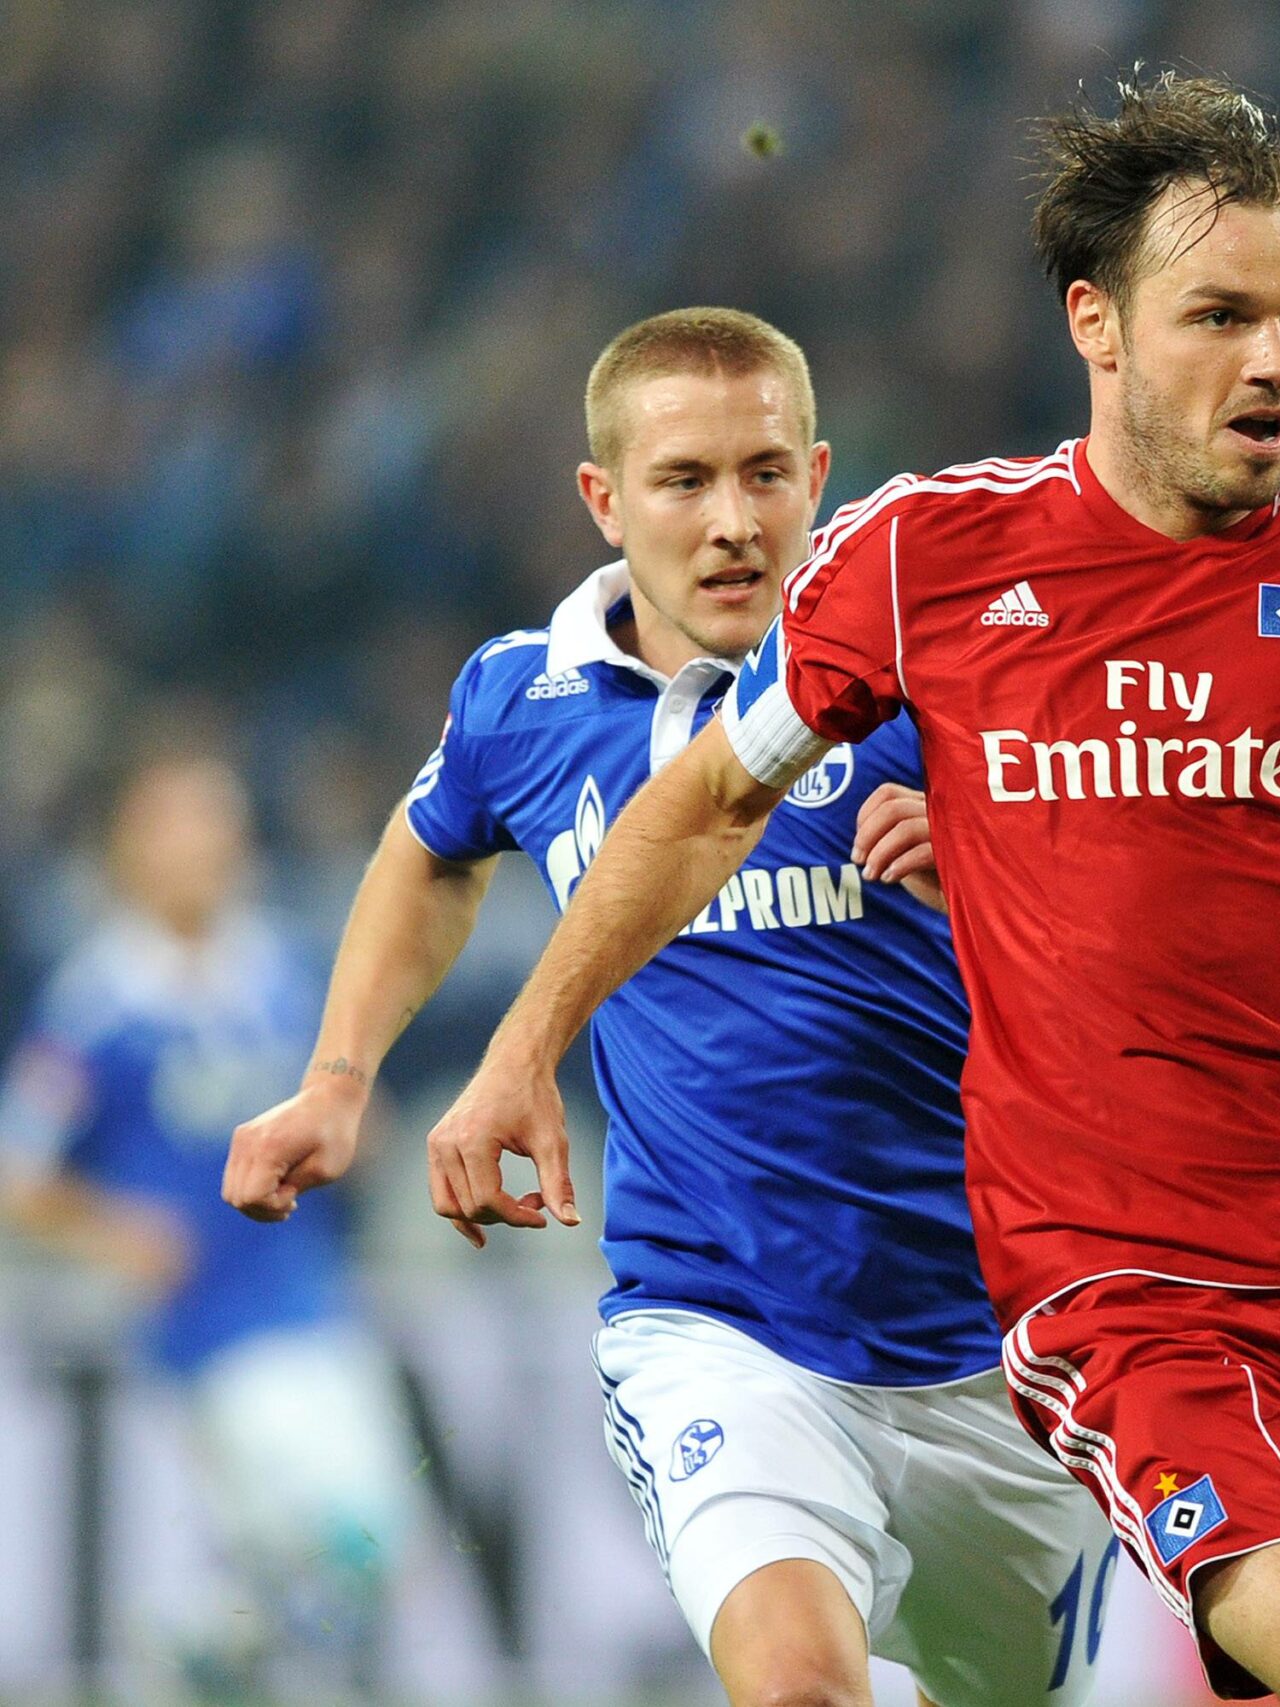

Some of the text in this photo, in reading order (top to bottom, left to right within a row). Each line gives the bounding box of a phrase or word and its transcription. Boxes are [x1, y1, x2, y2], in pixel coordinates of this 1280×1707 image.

[980, 608, 1050, 628] adidas
[525, 678, 590, 701] adidas
[1104, 659, 1214, 723] Fly
[677, 863, 864, 936] ZPROM
